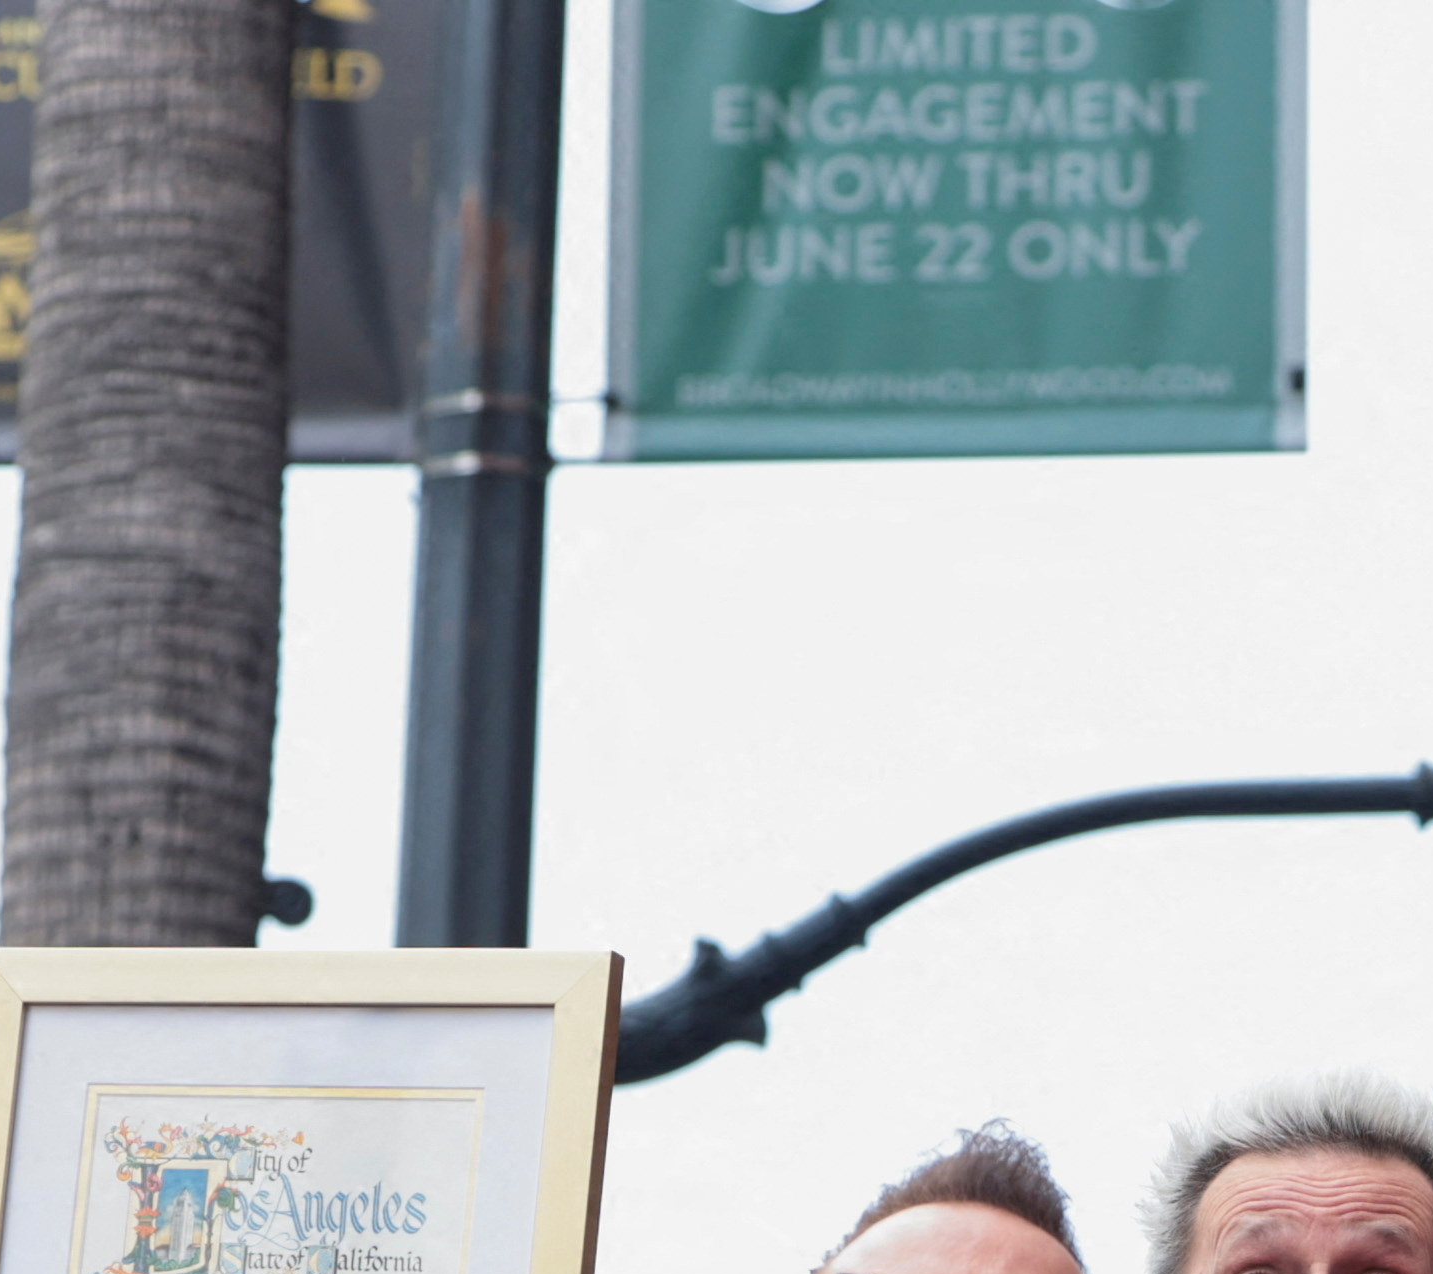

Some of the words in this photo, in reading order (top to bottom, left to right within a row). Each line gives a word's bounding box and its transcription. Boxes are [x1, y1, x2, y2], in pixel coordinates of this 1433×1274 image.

[822, 14, 1098, 75] LIMITED
[711, 79, 1207, 145] ENGAGEMENT
[764, 152, 945, 213] NOW
[958, 150, 1153, 209] THRU
[710, 224, 895, 287] JUNE
[915, 222, 993, 283] 22
[1007, 217, 1203, 279] ONLY
[228, 1146, 285, 1182] City
[287, 1147, 313, 1174] of
[270, 1173, 427, 1245] Angeles
[286, 1244, 307, 1270] of
